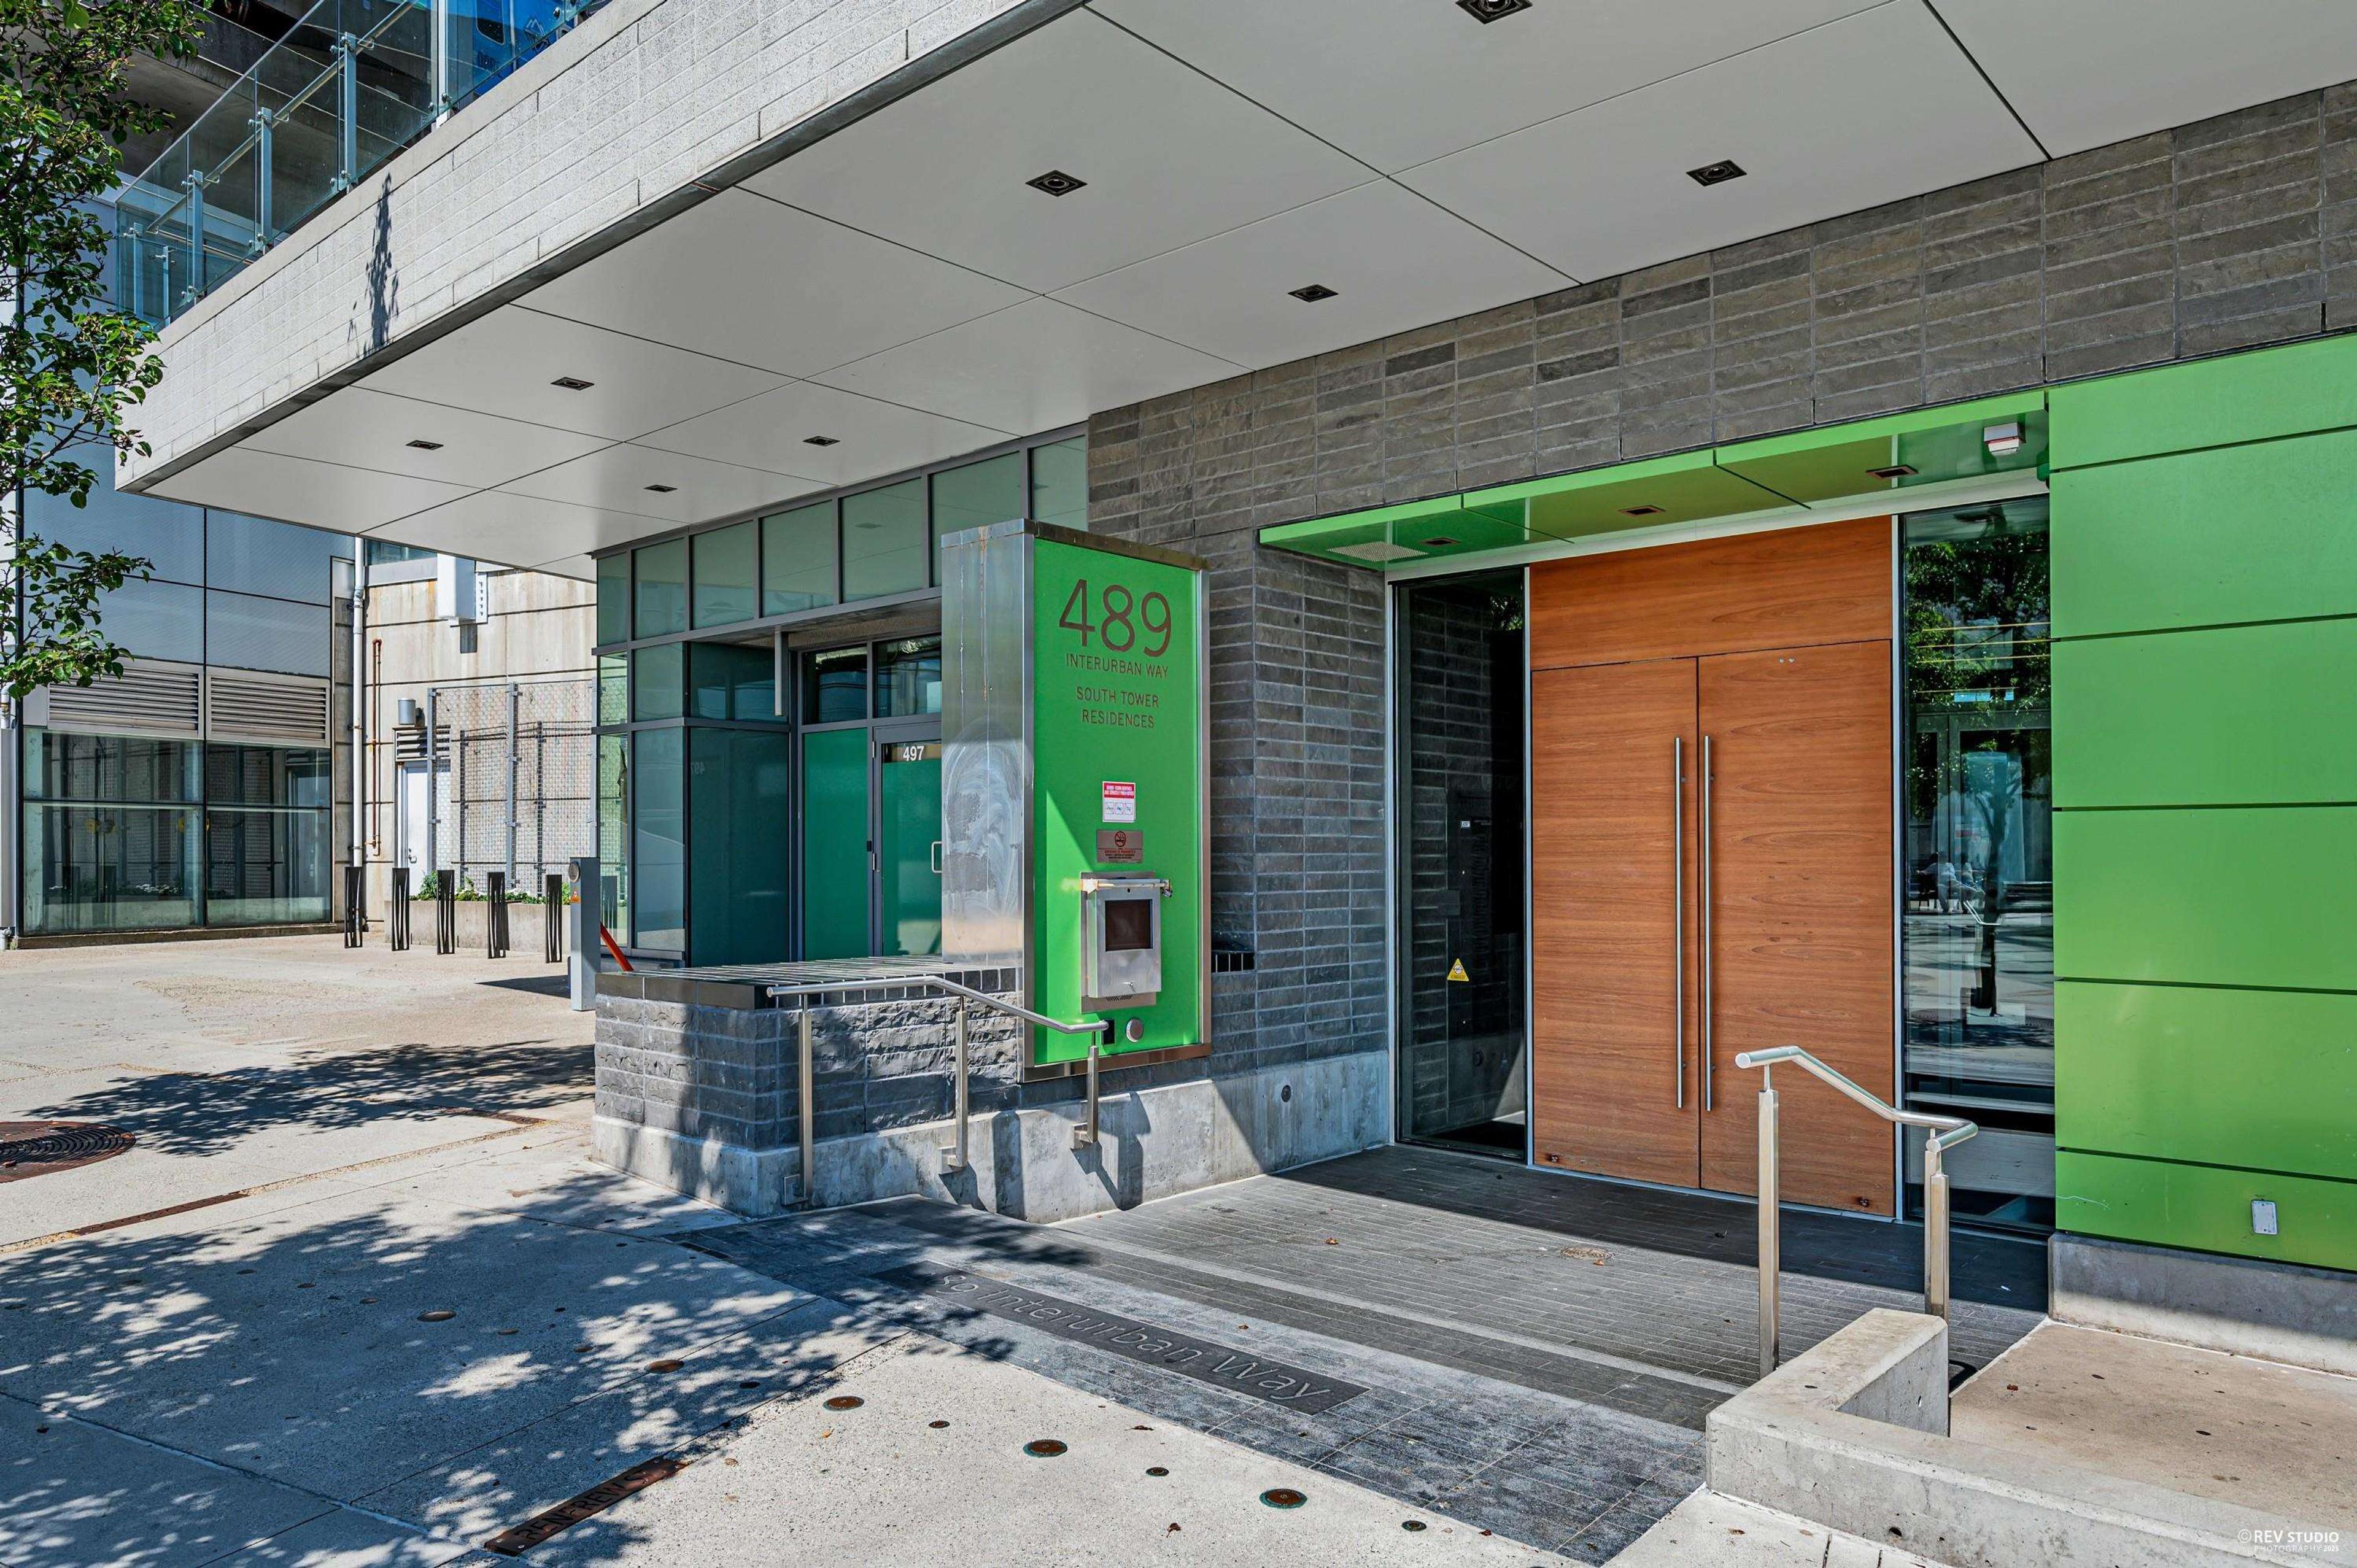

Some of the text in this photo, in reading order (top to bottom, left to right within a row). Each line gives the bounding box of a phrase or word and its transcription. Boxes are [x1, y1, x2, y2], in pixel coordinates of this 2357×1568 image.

[1059, 579, 1172, 657] 489
[1066, 653, 1168, 679] INTERURBAN WAY
[1076, 686, 1159, 708] SOUTH TOWER
[1082, 709, 1155, 728] RESIDENCES
[902, 745, 924, 761] 497
[977, 1289, 1203, 1363] Interurban
[1211, 1355, 1333, 1400] Way
